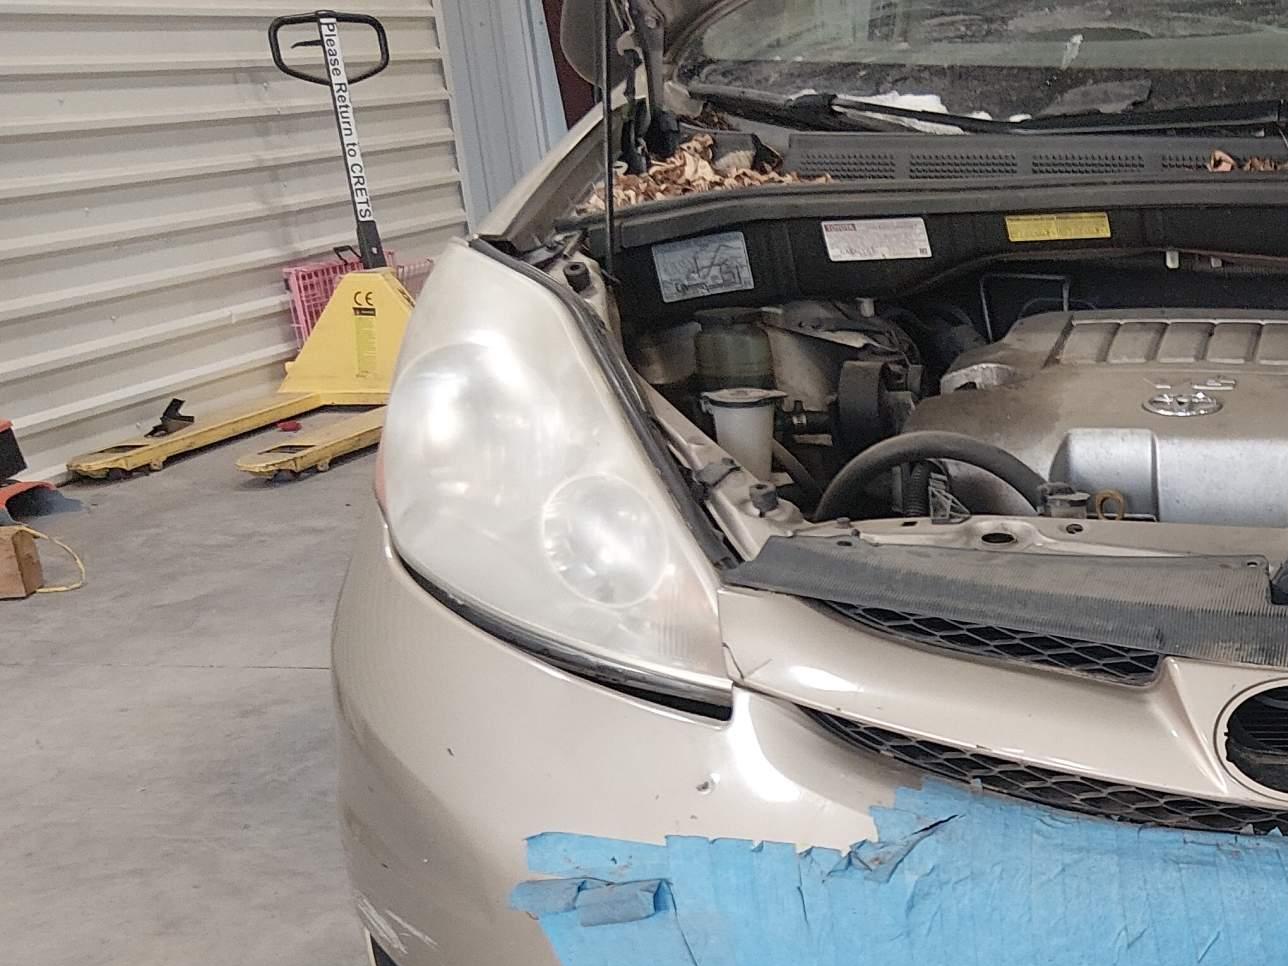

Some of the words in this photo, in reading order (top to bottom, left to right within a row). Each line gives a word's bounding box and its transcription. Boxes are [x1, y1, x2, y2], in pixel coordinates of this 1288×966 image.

[321, 23, 342, 77] Please
[334, 82, 353, 137] Return
[346, 142, 358, 158] to
[350, 163, 372, 219] CRETS
